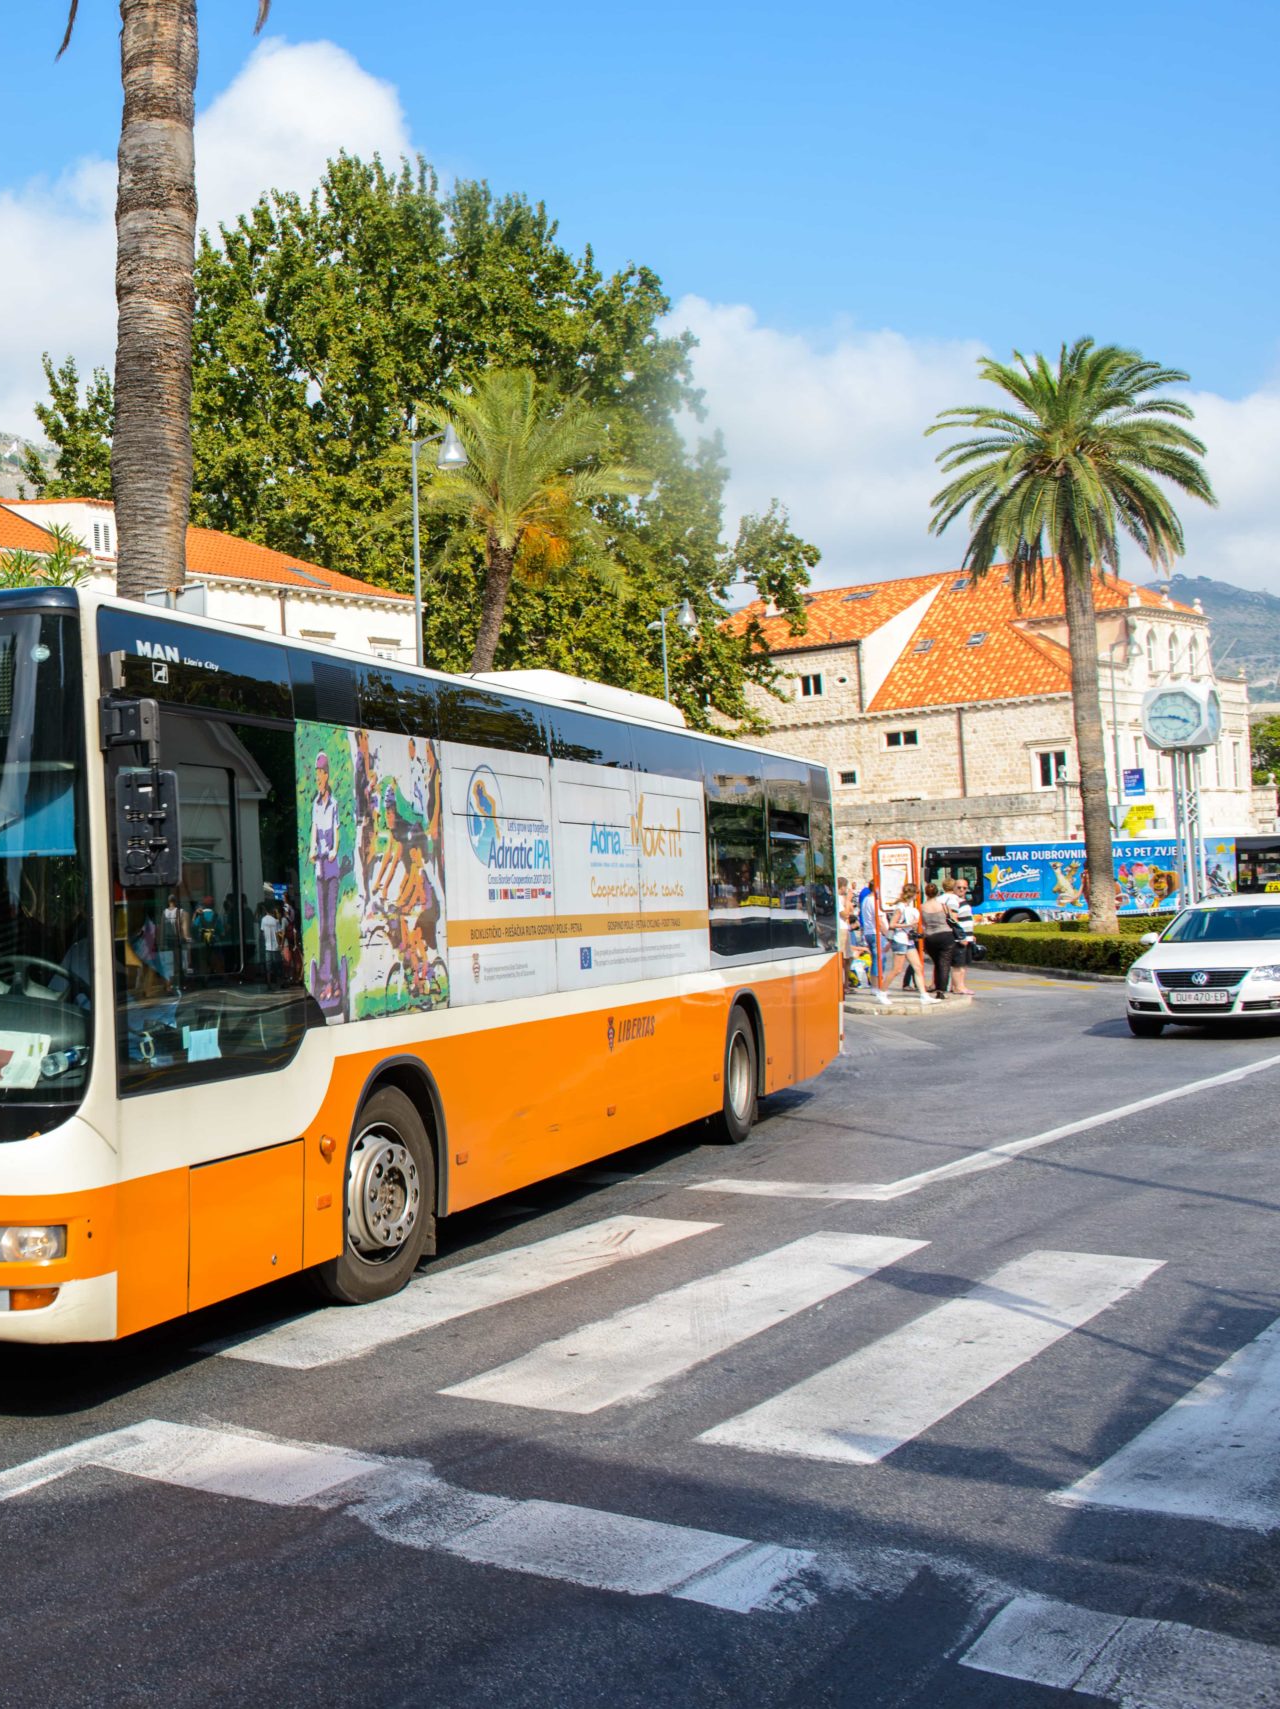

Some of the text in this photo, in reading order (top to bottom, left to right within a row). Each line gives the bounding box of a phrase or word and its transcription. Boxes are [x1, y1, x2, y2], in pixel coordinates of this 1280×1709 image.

[136, 640, 180, 663] MAN
[204, 661, 220, 672] City
[488, 836, 551, 870] Adriatic IPA
[1031, 849, 1087, 861] DUBROVNIK
[1124, 847, 1132, 857] S
[1133, 846, 1152, 857] PET
[590, 875, 638, 907] Cooperation
[1175, 993, 1187, 1002] DU
[618, 1016, 656, 1043] LIBERTAS
